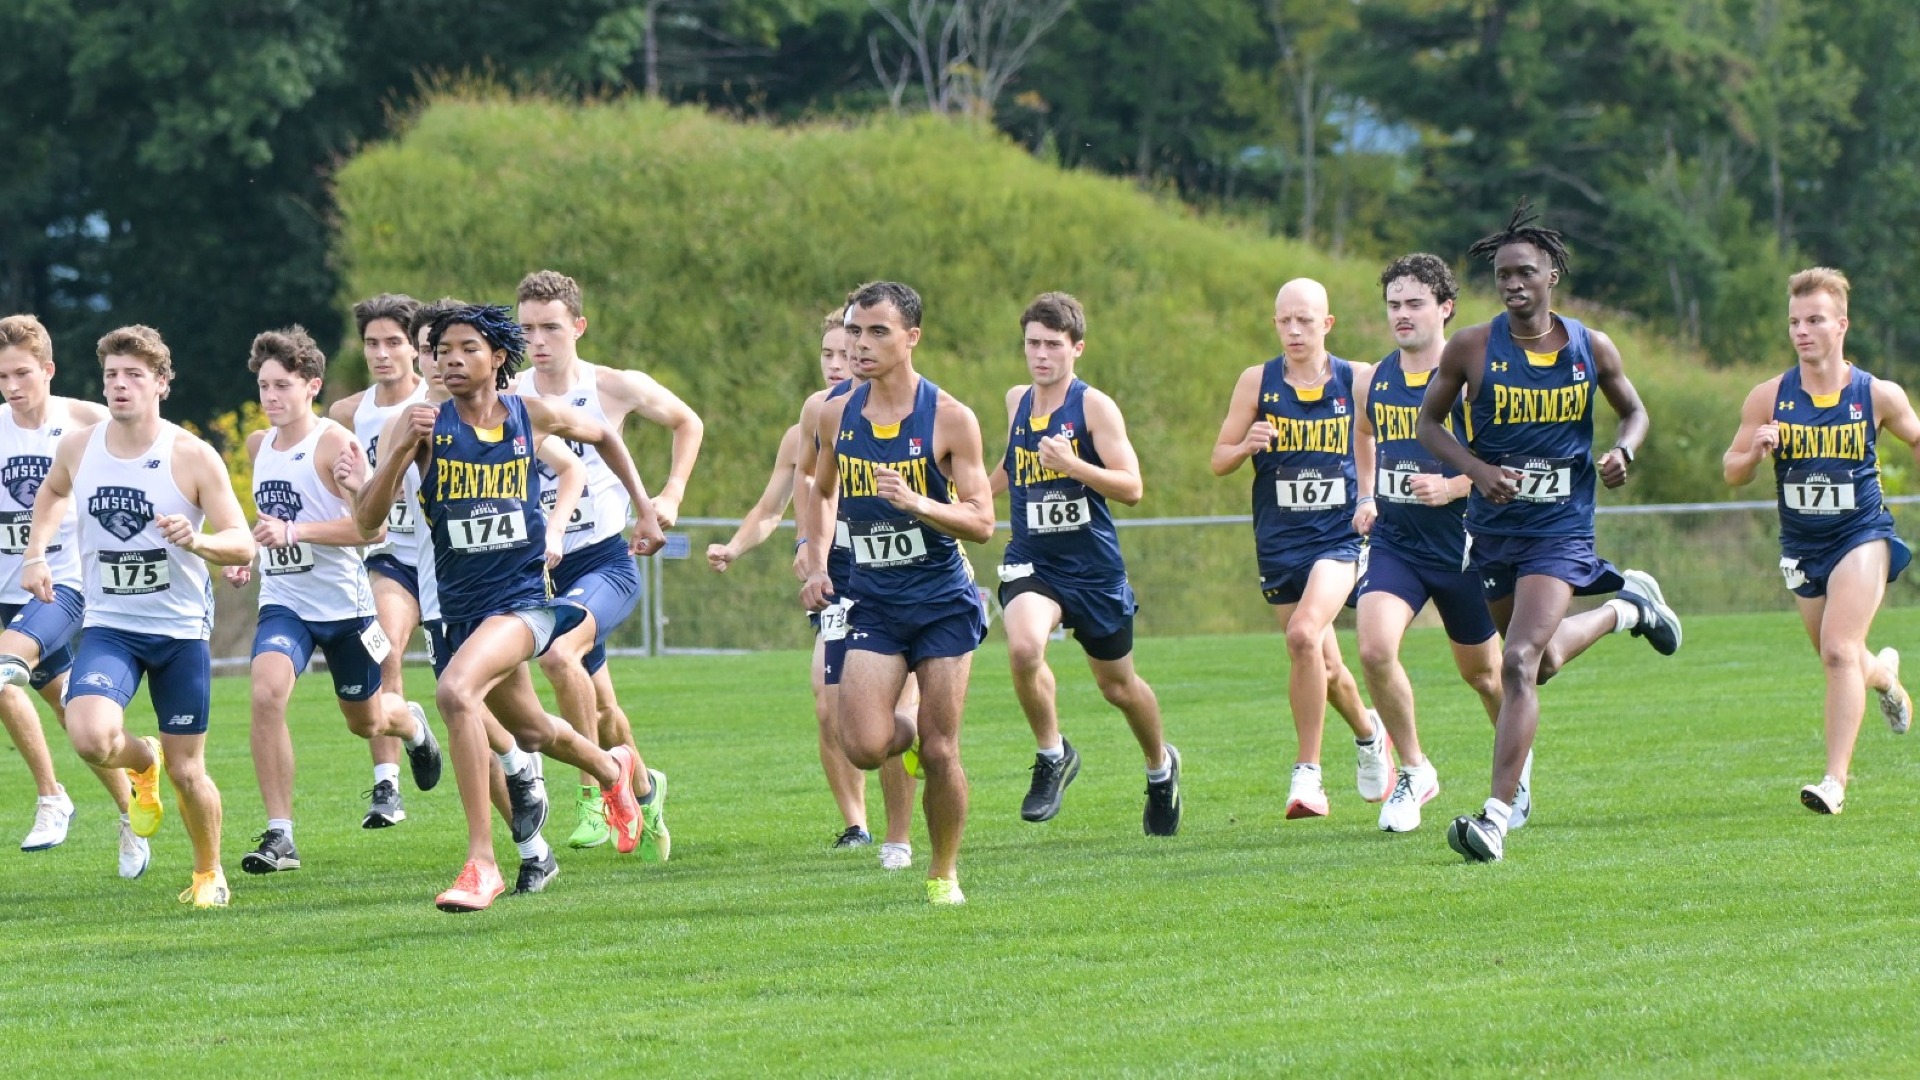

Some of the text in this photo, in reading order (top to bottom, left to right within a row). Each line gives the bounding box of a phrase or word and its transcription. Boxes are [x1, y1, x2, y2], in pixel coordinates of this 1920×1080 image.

[1494, 381, 1590, 424] PENMEN
[1265, 413, 1351, 455] PENMEN
[1779, 420, 1867, 461] PENMEN
[4, 464, 50, 483] ANSEL
[437, 457, 531, 502] PENMEN
[838, 453, 928, 498] PENEN
[1388, 472, 1413, 497] 16
[1514, 469, 1559, 494] 172
[100, 488, 143, 500] SAINT
[257, 489, 301, 508] ANSELM
[1289, 481, 1334, 504] 167
[1796, 486, 1840, 508] 171
[91, 497, 151, 517] ANSELM
[1036, 502, 1081, 526] 168
[6, 525, 31, 547] 18
[461, 514, 515, 545] 174
[267, 544, 302, 567] 180
[863, 533, 913, 560] 170
[111, 563, 158, 587] 175
[168, 714, 194, 725] NB
